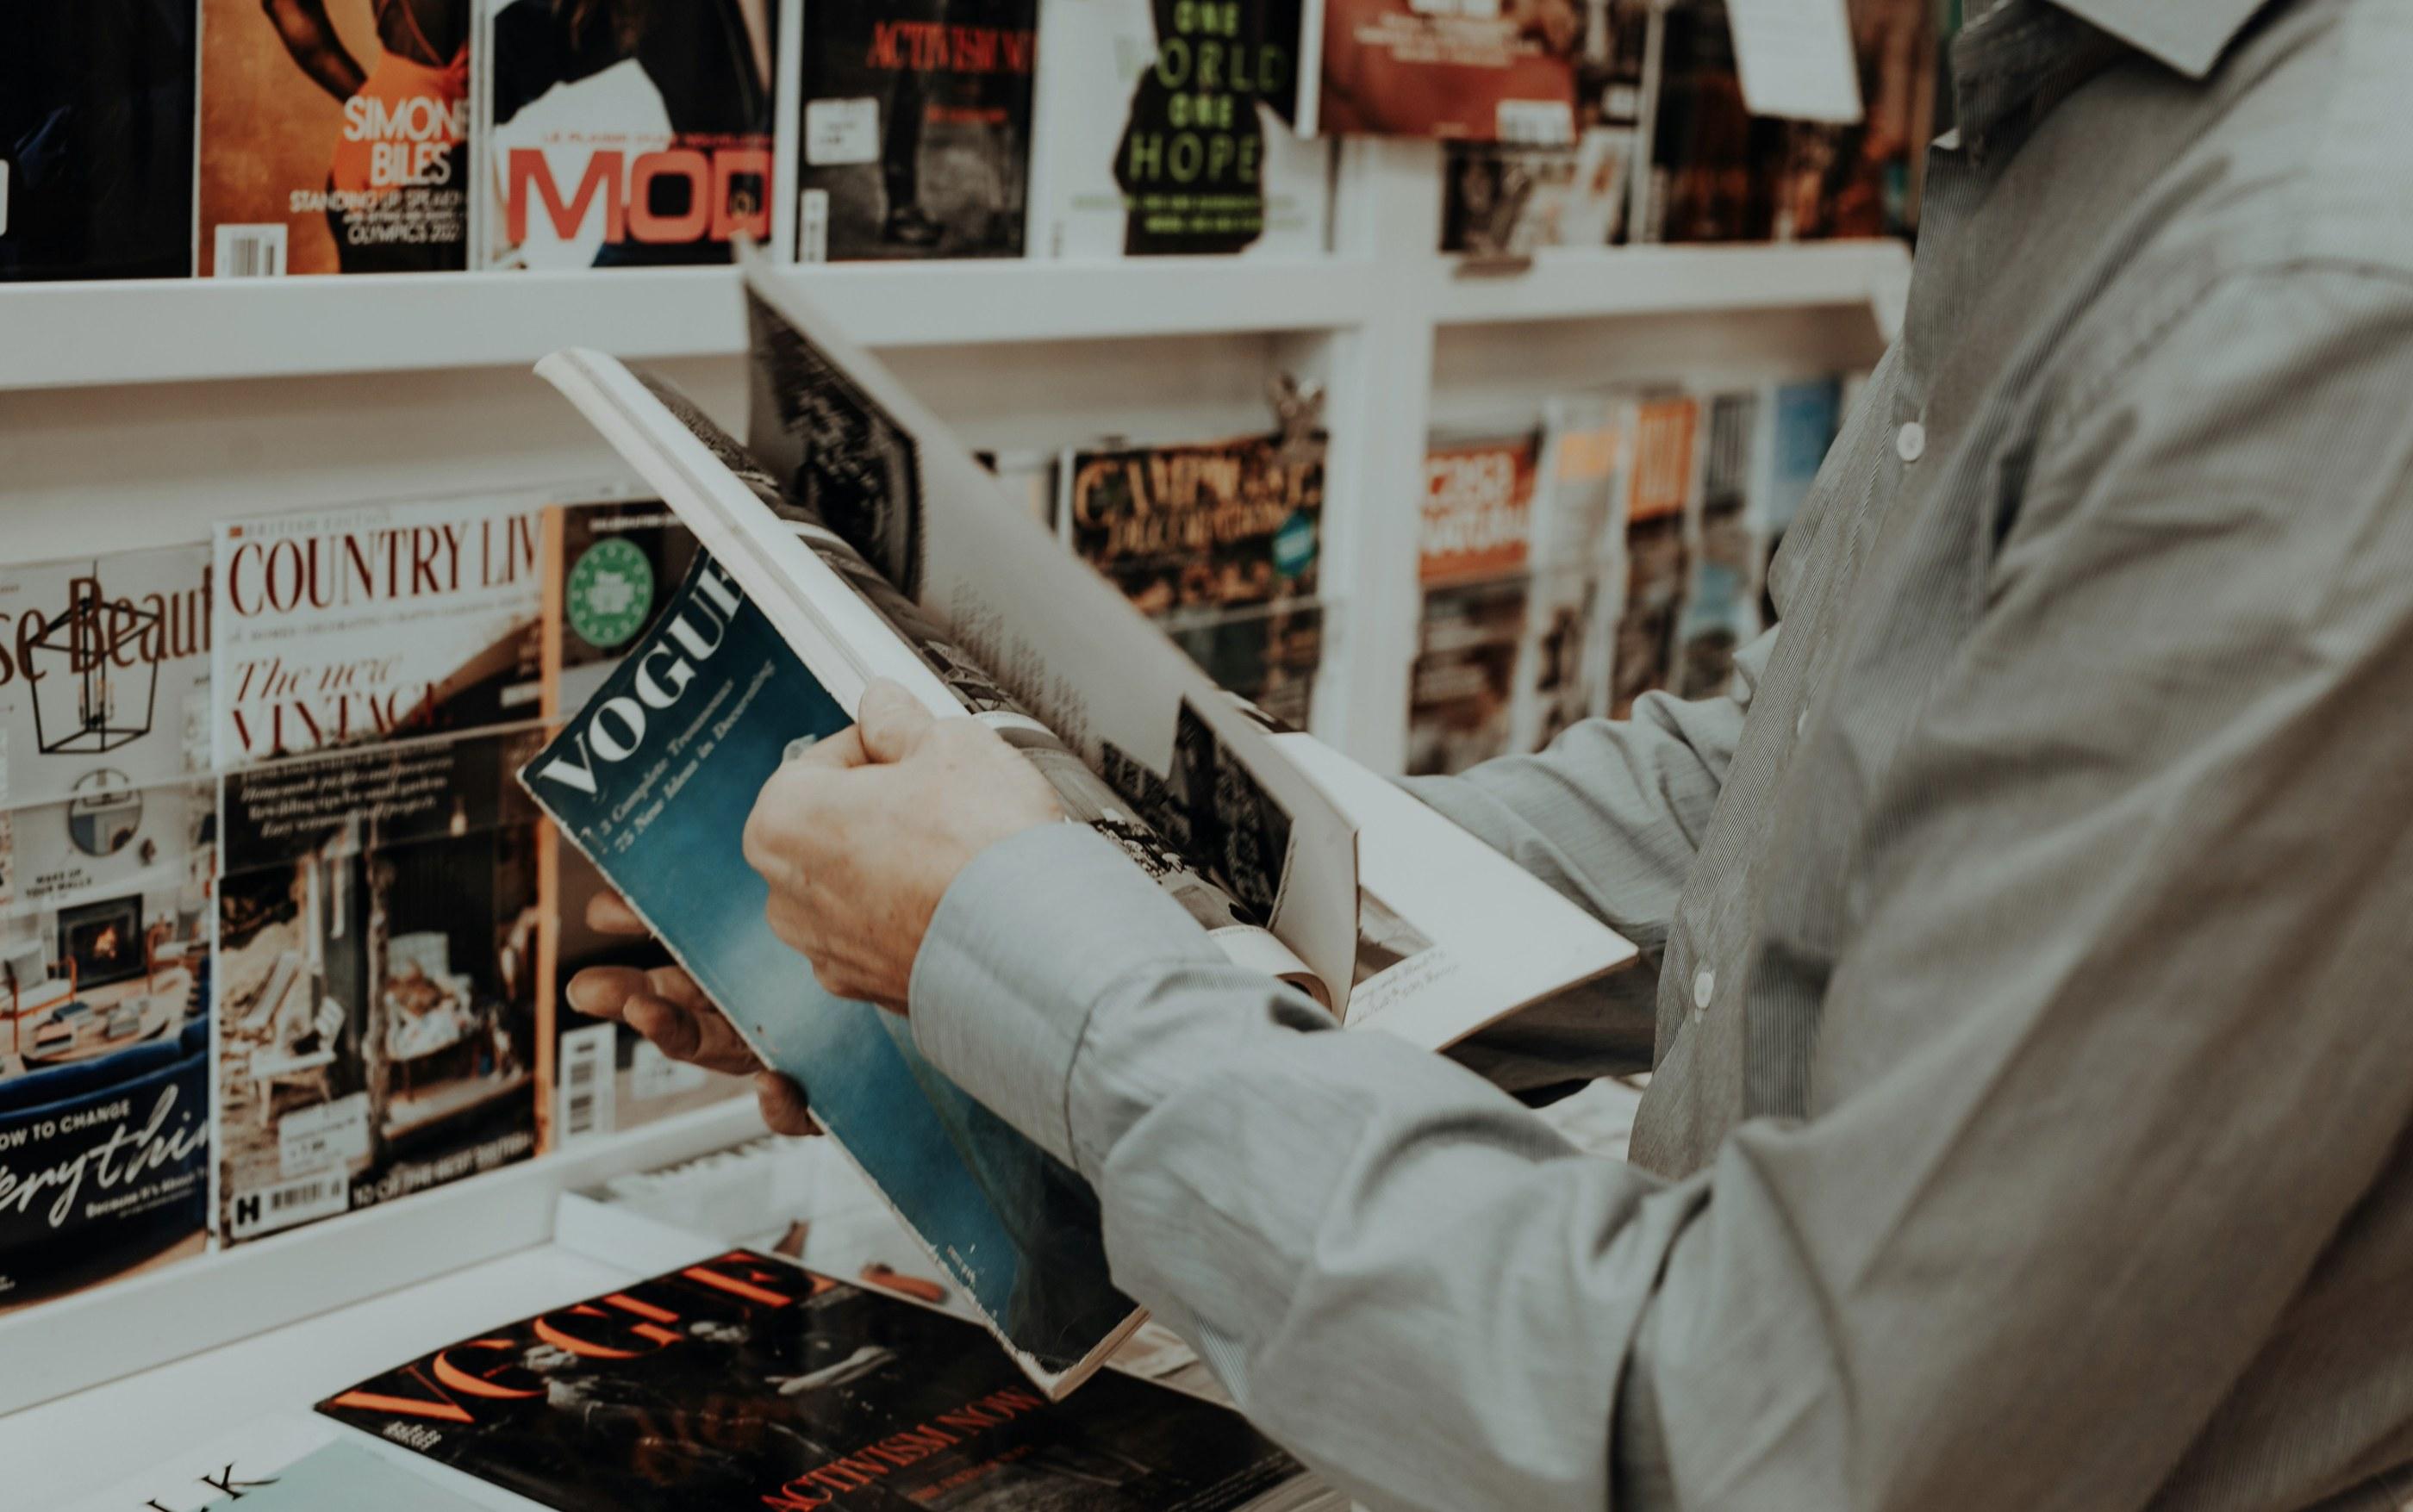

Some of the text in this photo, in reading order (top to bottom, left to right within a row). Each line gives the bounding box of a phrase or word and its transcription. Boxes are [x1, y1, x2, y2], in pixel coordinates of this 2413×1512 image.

[1174, 0, 1239, 36] ONE
[1156, 37, 1288, 92] ORLD
[1168, 91, 1234, 129] ONE
[370, 141, 452, 187] BILES
[1129, 132, 1260, 183] HOPE
[228, 520, 469, 618] COUNTRY
[236, 655, 312, 703] The
[33, 1123, 56, 1142] TO
[59, 1099, 131, 1134] CHANGE
[237, 1194, 260, 1227] H
[935, 1386, 1043, 1437] NOW
